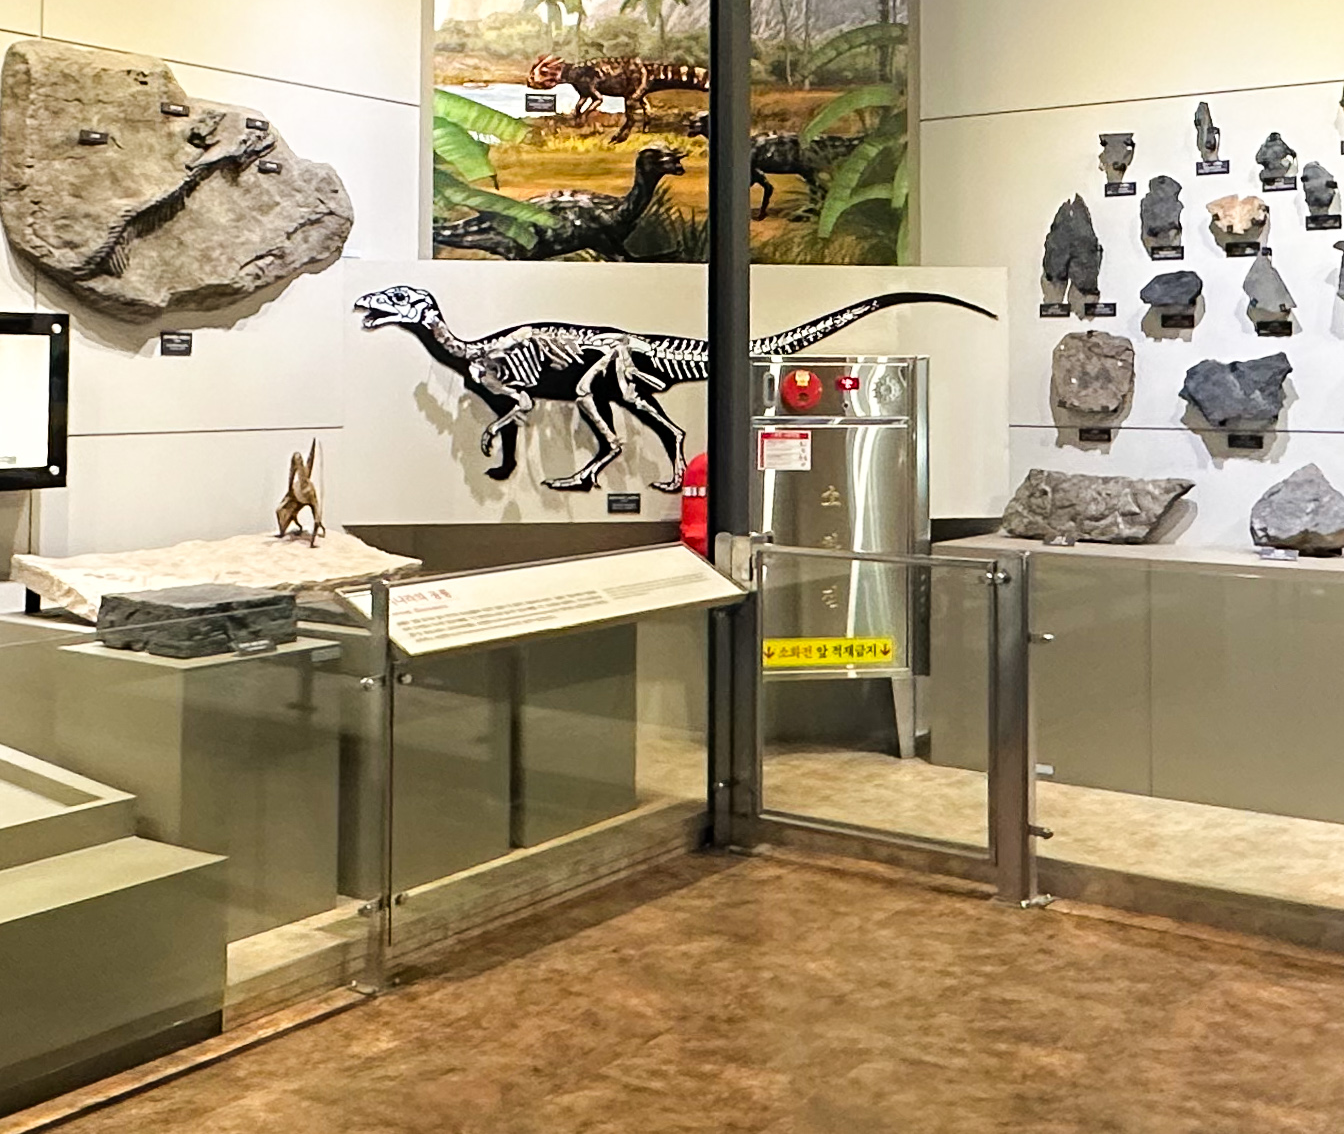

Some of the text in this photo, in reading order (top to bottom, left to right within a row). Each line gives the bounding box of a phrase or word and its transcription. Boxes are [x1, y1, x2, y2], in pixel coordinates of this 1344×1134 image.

[778, 643, 878, 659] 소화전 앞 적재금지
